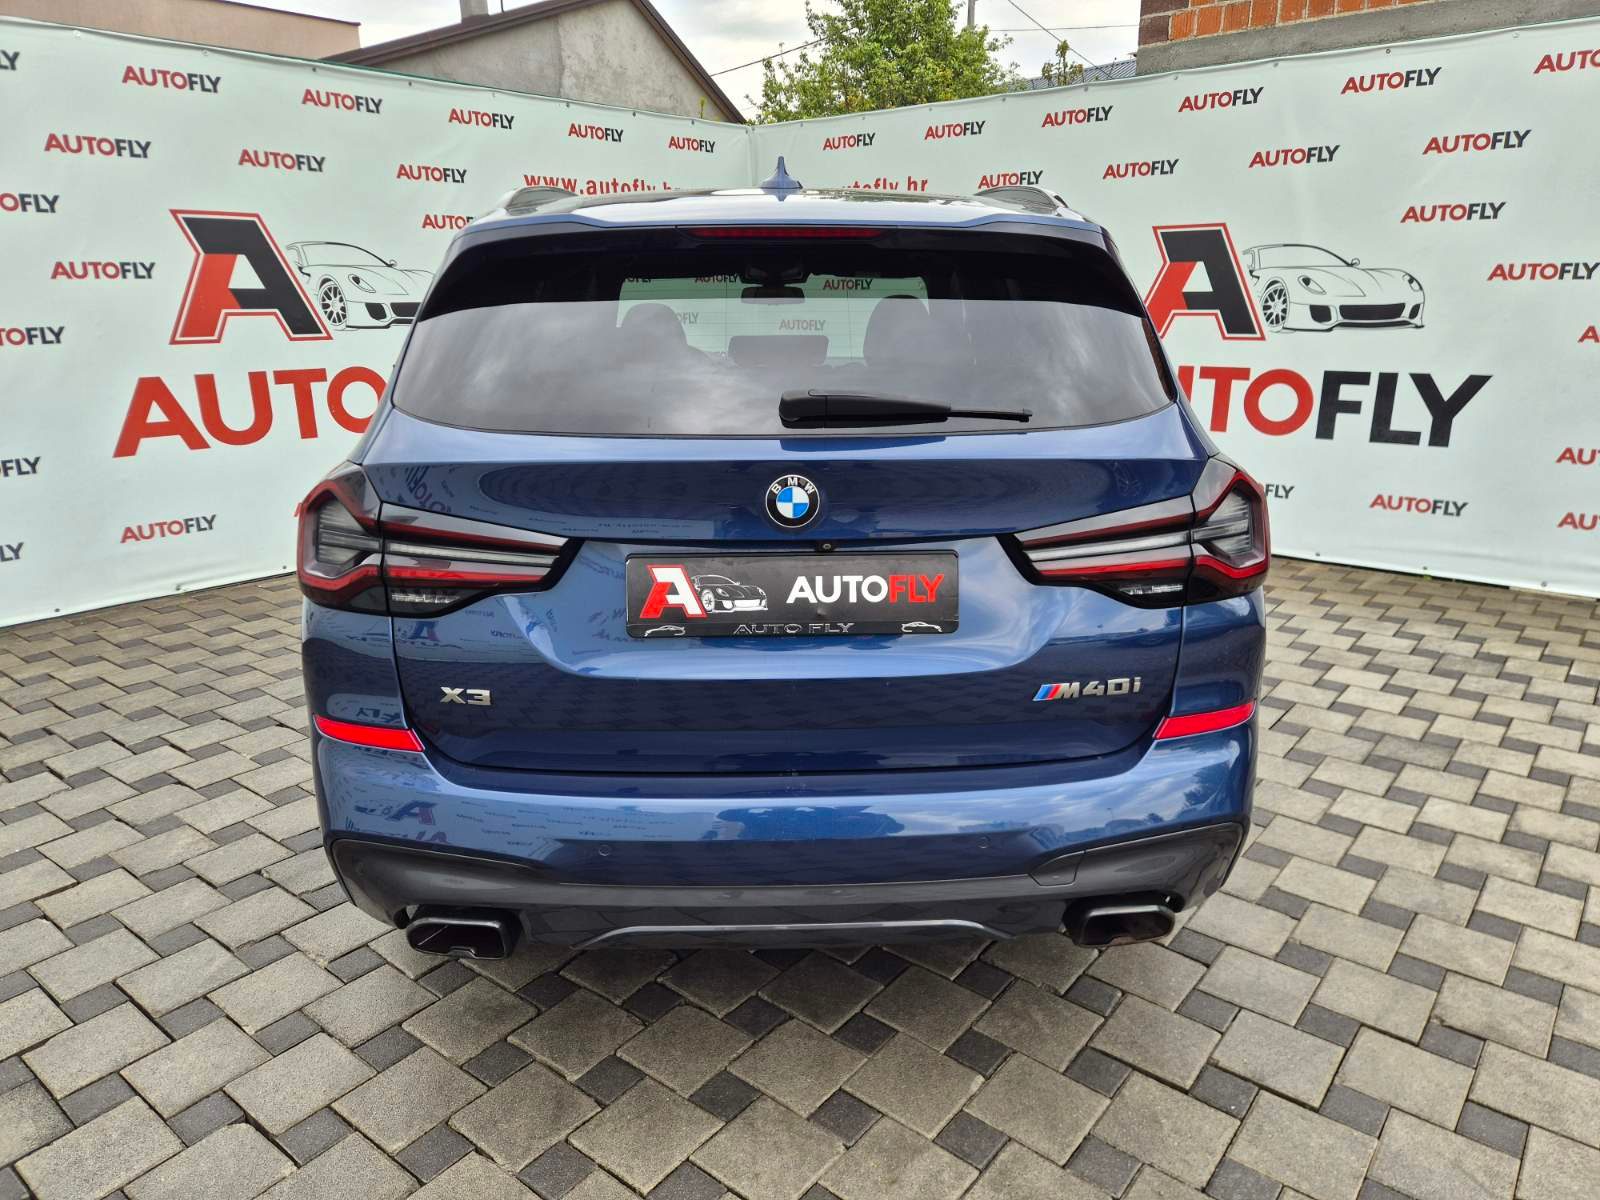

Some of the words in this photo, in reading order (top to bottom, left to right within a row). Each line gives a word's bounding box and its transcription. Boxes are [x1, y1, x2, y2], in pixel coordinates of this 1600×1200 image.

[122, 65, 221, 93] AUTOFLY
[1341, 67, 1442, 94] AUTOFLY
[302, 88, 383, 114] AUTOFLY
[1178, 87, 1264, 112] AUTOFLY
[449, 108, 514, 129] AUTOFLY
[1042, 105, 1113, 127] AUTOFLY
[568, 123, 624, 142] AUTOFLY
[925, 120, 985, 140] AUTOFLY
[44, 133, 151, 158] AUTOFLY
[669, 135, 715, 153] AUTOFLY
[823, 133, 876, 150] AUTOFLY
[1423, 130, 1531, 155] AUTOFLY
[239, 149, 325, 172] AUTOFLY
[1249, 145, 1340, 168] AUTOFLY
[397, 163, 467, 183] AUTOFLY
[1103, 159, 1179, 179] AUTOFLY
[978, 170, 1043, 189] AUTOFLY
[0, 193, 60, 213] OFLY
[1401, 202, 1506, 223] AUTOFLY
[51, 261, 155, 279] AUTOFLY
[1487, 262, 1600, 281] AUTOFLY
[823, 279, 873, 290] AUTOFLY
[779, 320, 826, 331] AUTOFLY
[112, 366, 387, 458] AUTO
[1556, 447, 1600, 465] AU
[772, 476, 815, 494] BMW
[1370, 494, 1468, 517] AUTOFLY
[120, 514, 216, 543] AUTOFLY
[1557, 511, 1600, 530] AU
[787, 573, 945, 604] AUTOFLY
[733, 623, 802, 635] AUTO
[808, 622, 855, 633] FLY
[440, 686, 491, 706] X3
[1050, 677, 1141, 699] M40i
